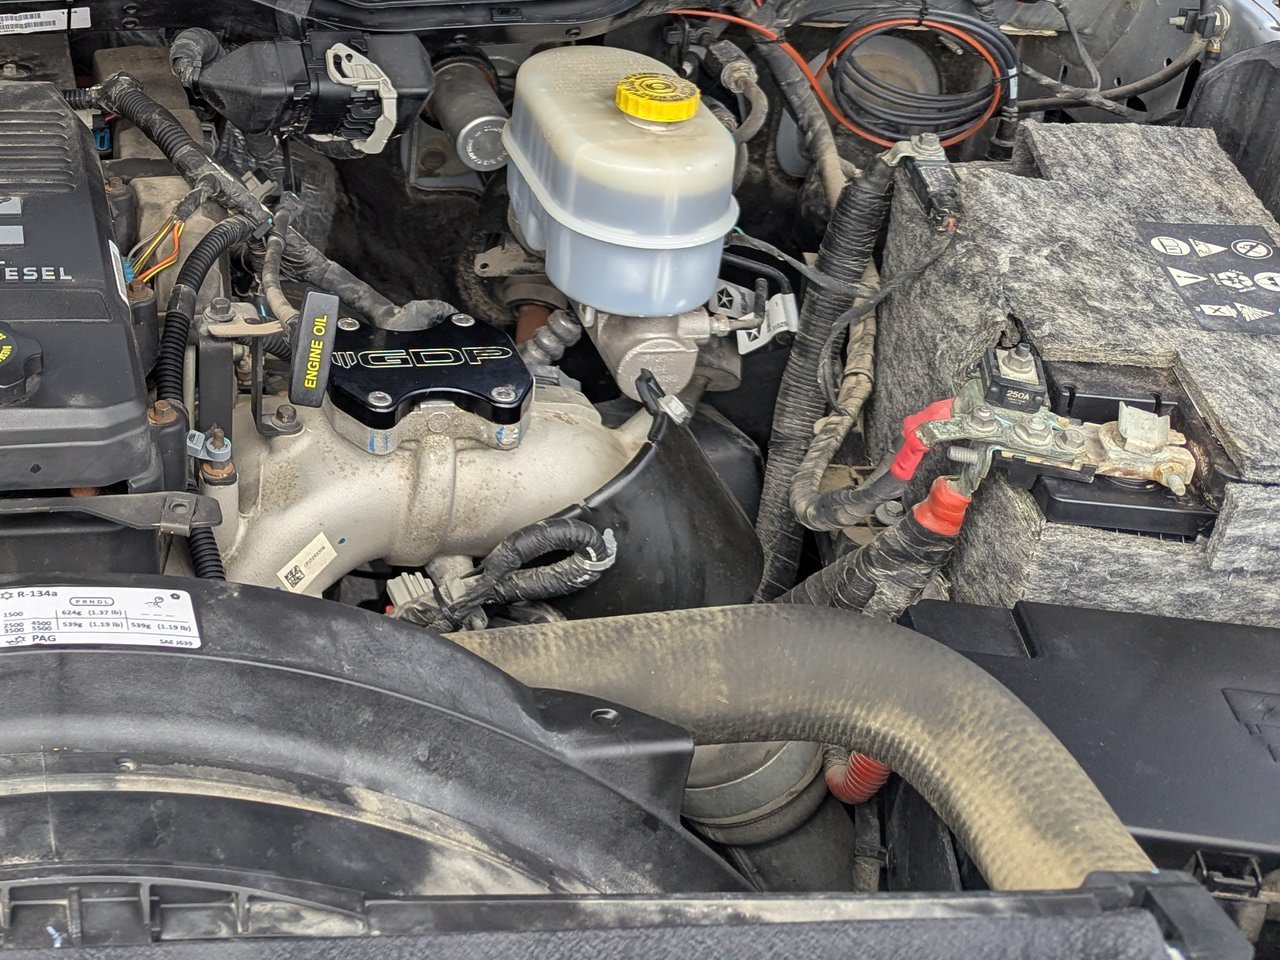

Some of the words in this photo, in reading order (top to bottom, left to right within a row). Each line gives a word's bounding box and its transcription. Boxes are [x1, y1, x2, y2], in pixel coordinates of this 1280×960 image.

[304, 340, 324, 389] ENGINE
[314, 314, 328, 337] OIL
[357, 346, 513, 369] GDP
[1006, 390, 1029, 400] 250A
[17, 589, 58, 598] R-134a
[180, 624, 192, 632] lb)
[31, 634, 57, 642] PAG
